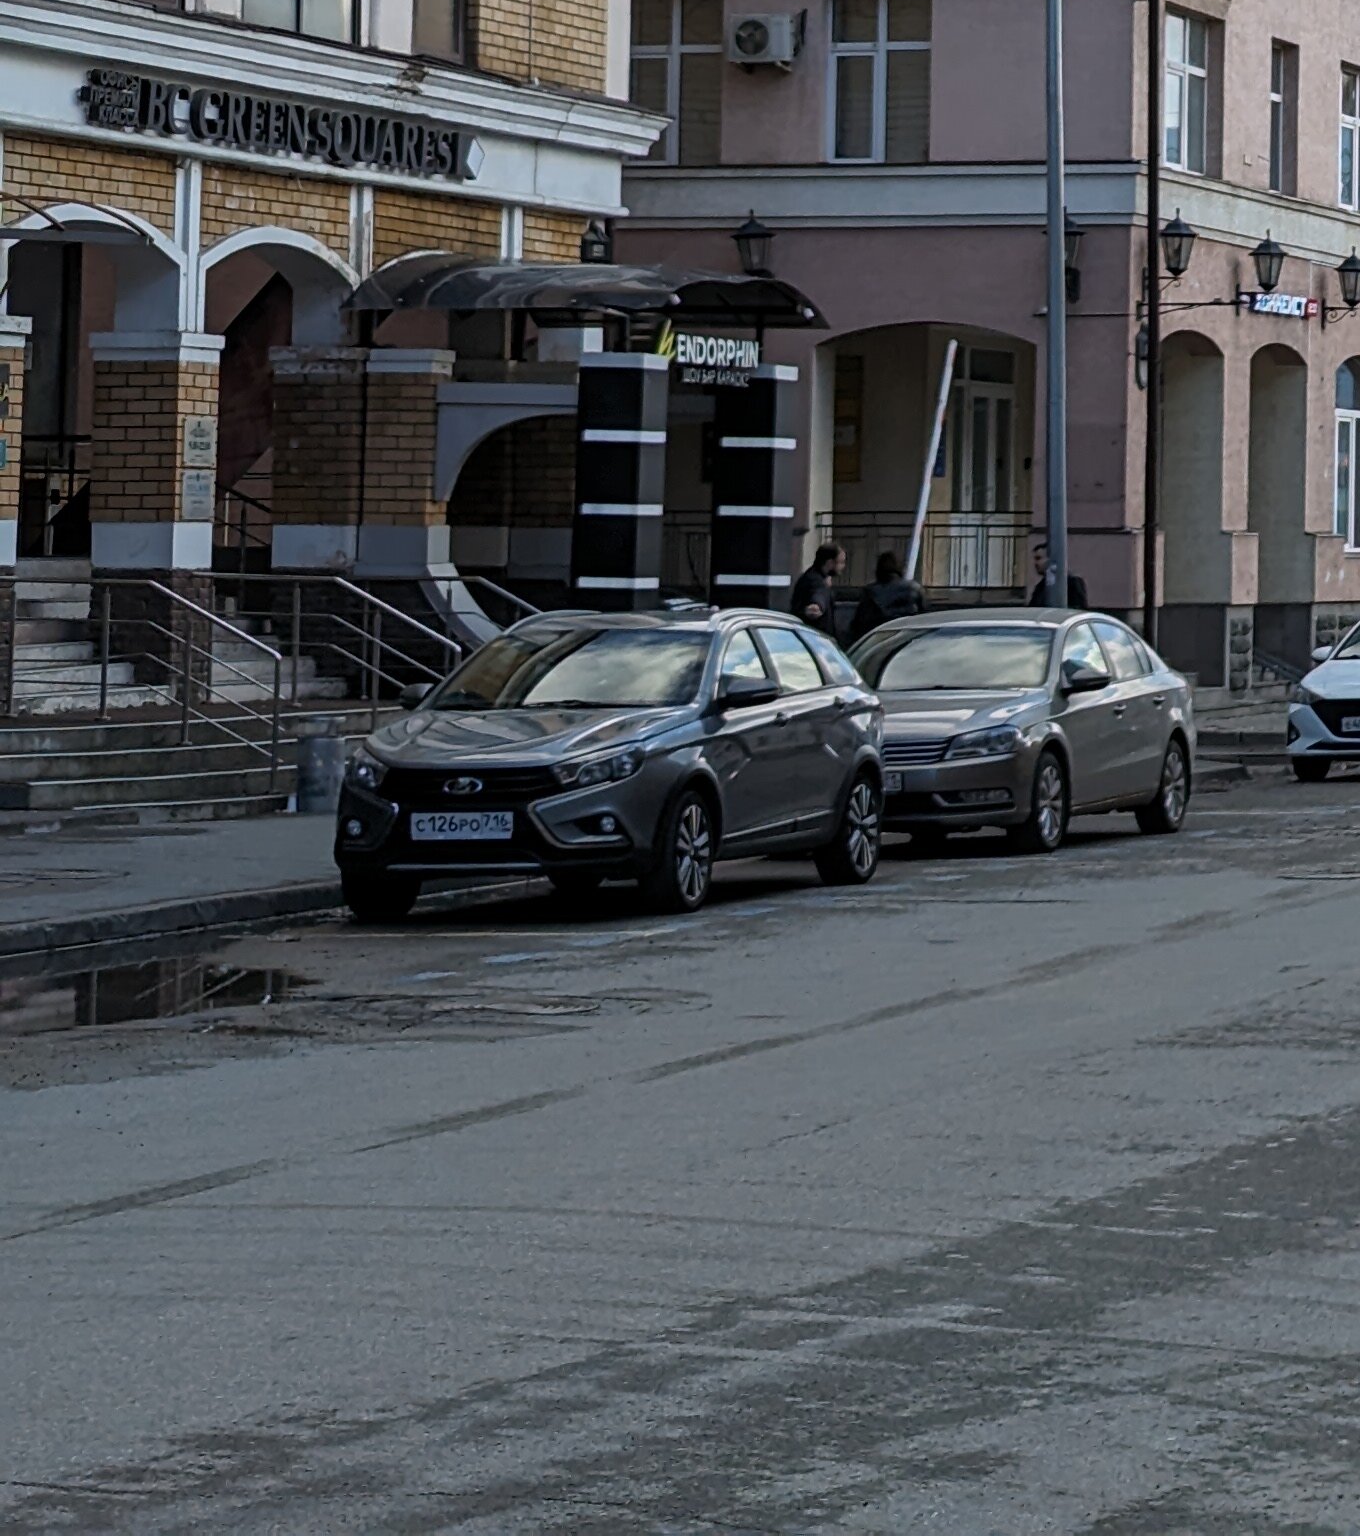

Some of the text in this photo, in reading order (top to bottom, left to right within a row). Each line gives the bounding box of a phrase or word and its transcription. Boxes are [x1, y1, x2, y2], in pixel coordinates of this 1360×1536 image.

[147, 79, 452, 174] BC GREEN SQUARES
[676, 333, 759, 368] ENDORPHIN
